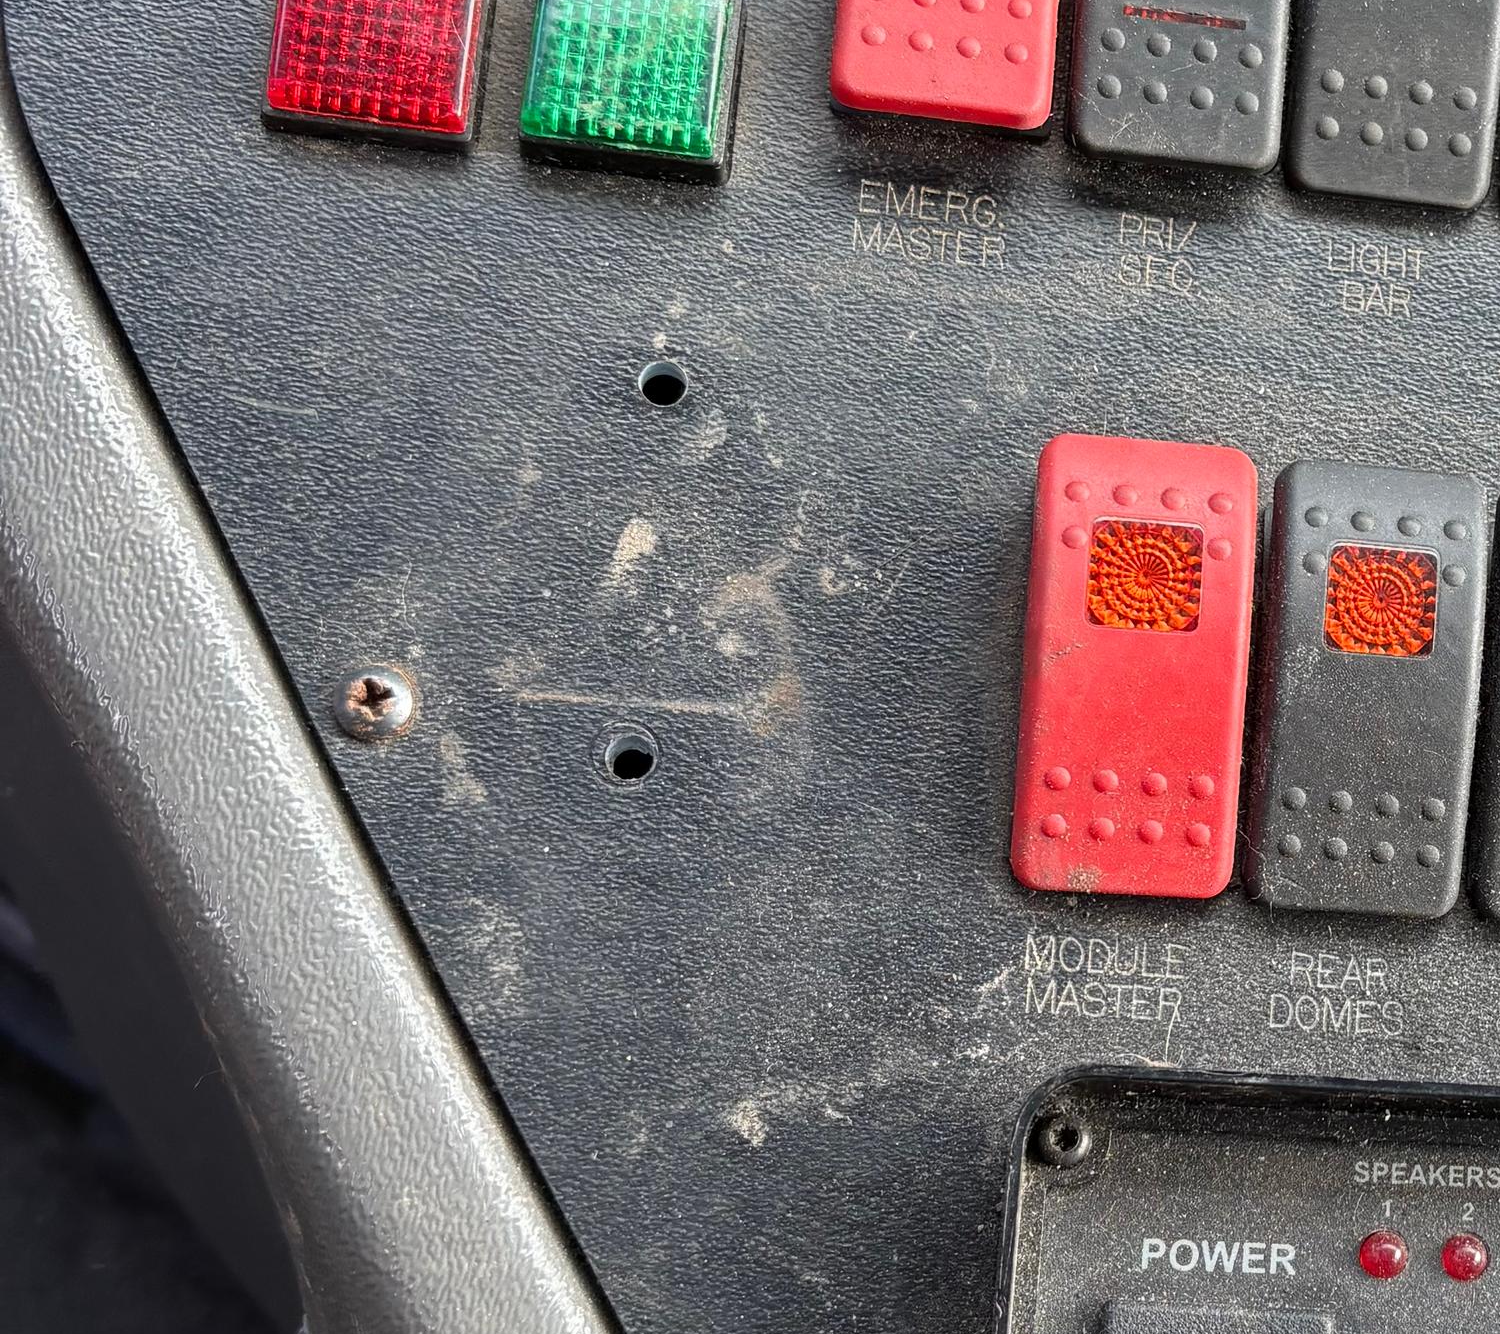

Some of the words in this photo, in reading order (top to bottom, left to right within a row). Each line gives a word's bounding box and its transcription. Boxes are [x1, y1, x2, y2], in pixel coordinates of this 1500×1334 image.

[851, 218, 1006, 270] MASTER
[1327, 238, 1428, 282] LIGHT
[1119, 253, 1195, 293] SEC
[1342, 280, 1412, 319] BAR
[1023, 933, 1190, 981] MODULE
[1289, 950, 1389, 993] REAR
[1023, 979, 1184, 1024] MASTER
[1267, 993, 1405, 1037] DOMES
[1382, 1200, 1393, 1217] 1
[1460, 1203, 1475, 1222] 2
[1141, 1237, 1297, 1277] POWER
